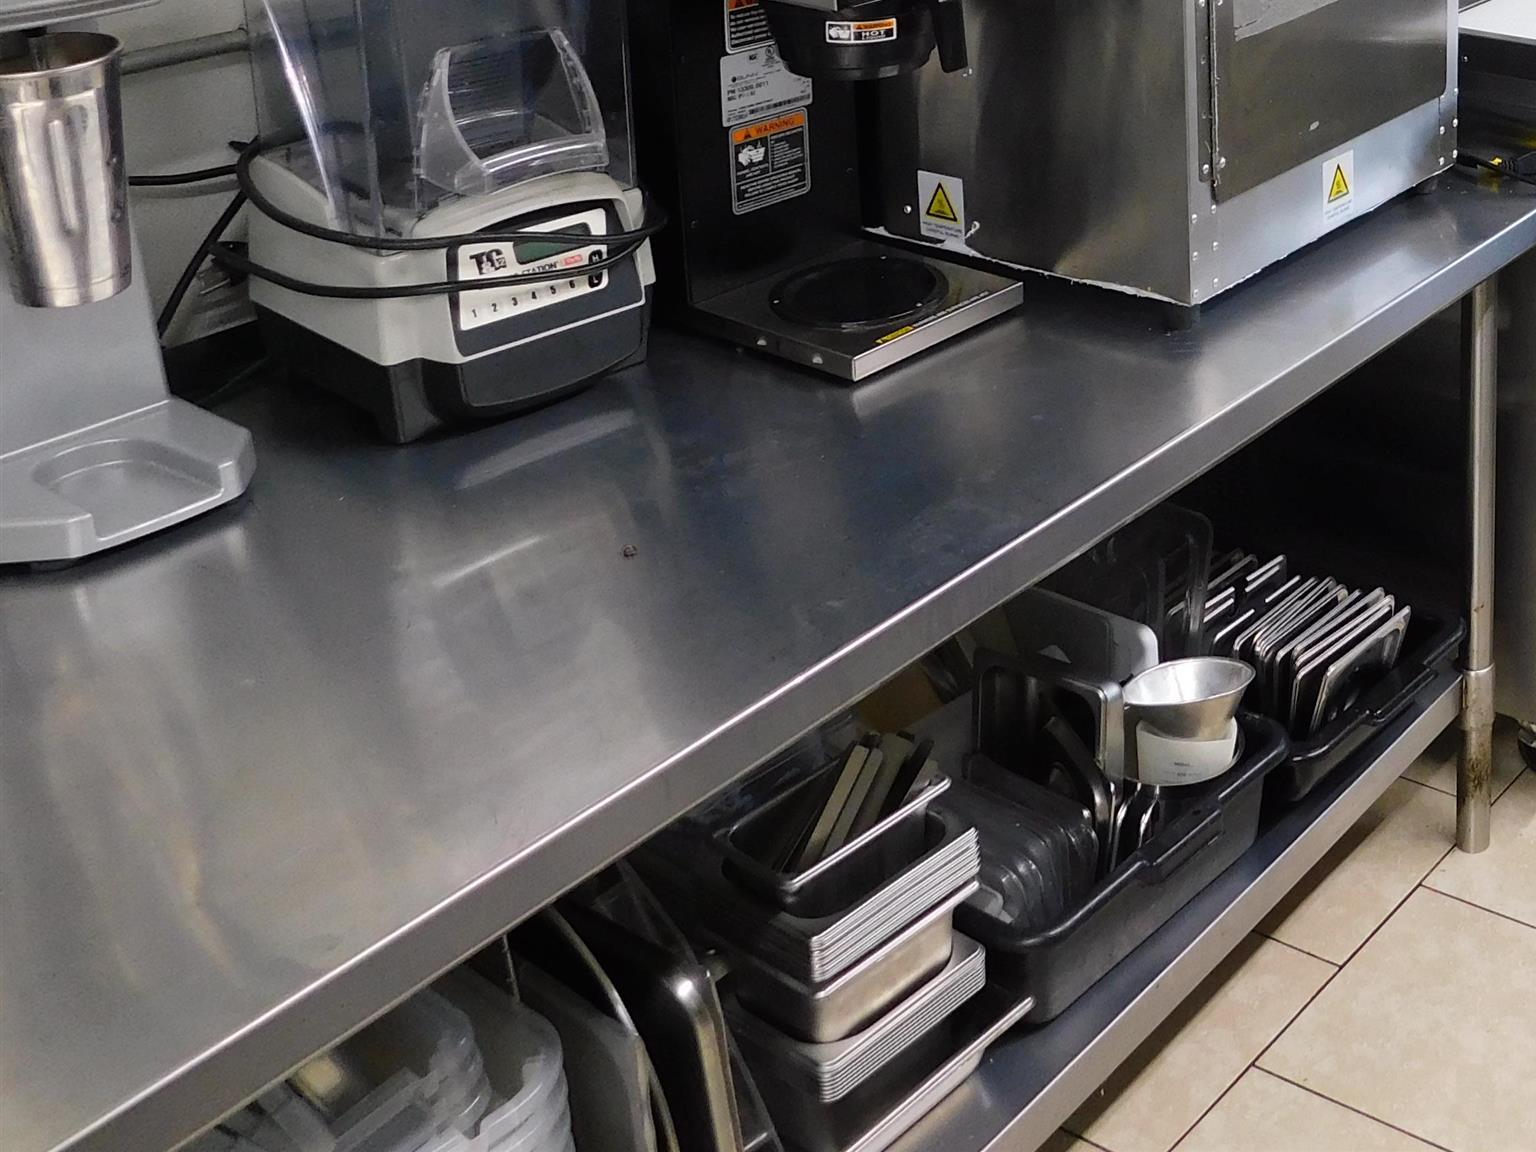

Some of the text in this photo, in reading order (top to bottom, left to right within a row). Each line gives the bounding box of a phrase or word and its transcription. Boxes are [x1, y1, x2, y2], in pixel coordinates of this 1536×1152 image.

[757, 117, 795, 135] WARNING
[471, 280, 576, 318] 1 2 3 4 5 6
